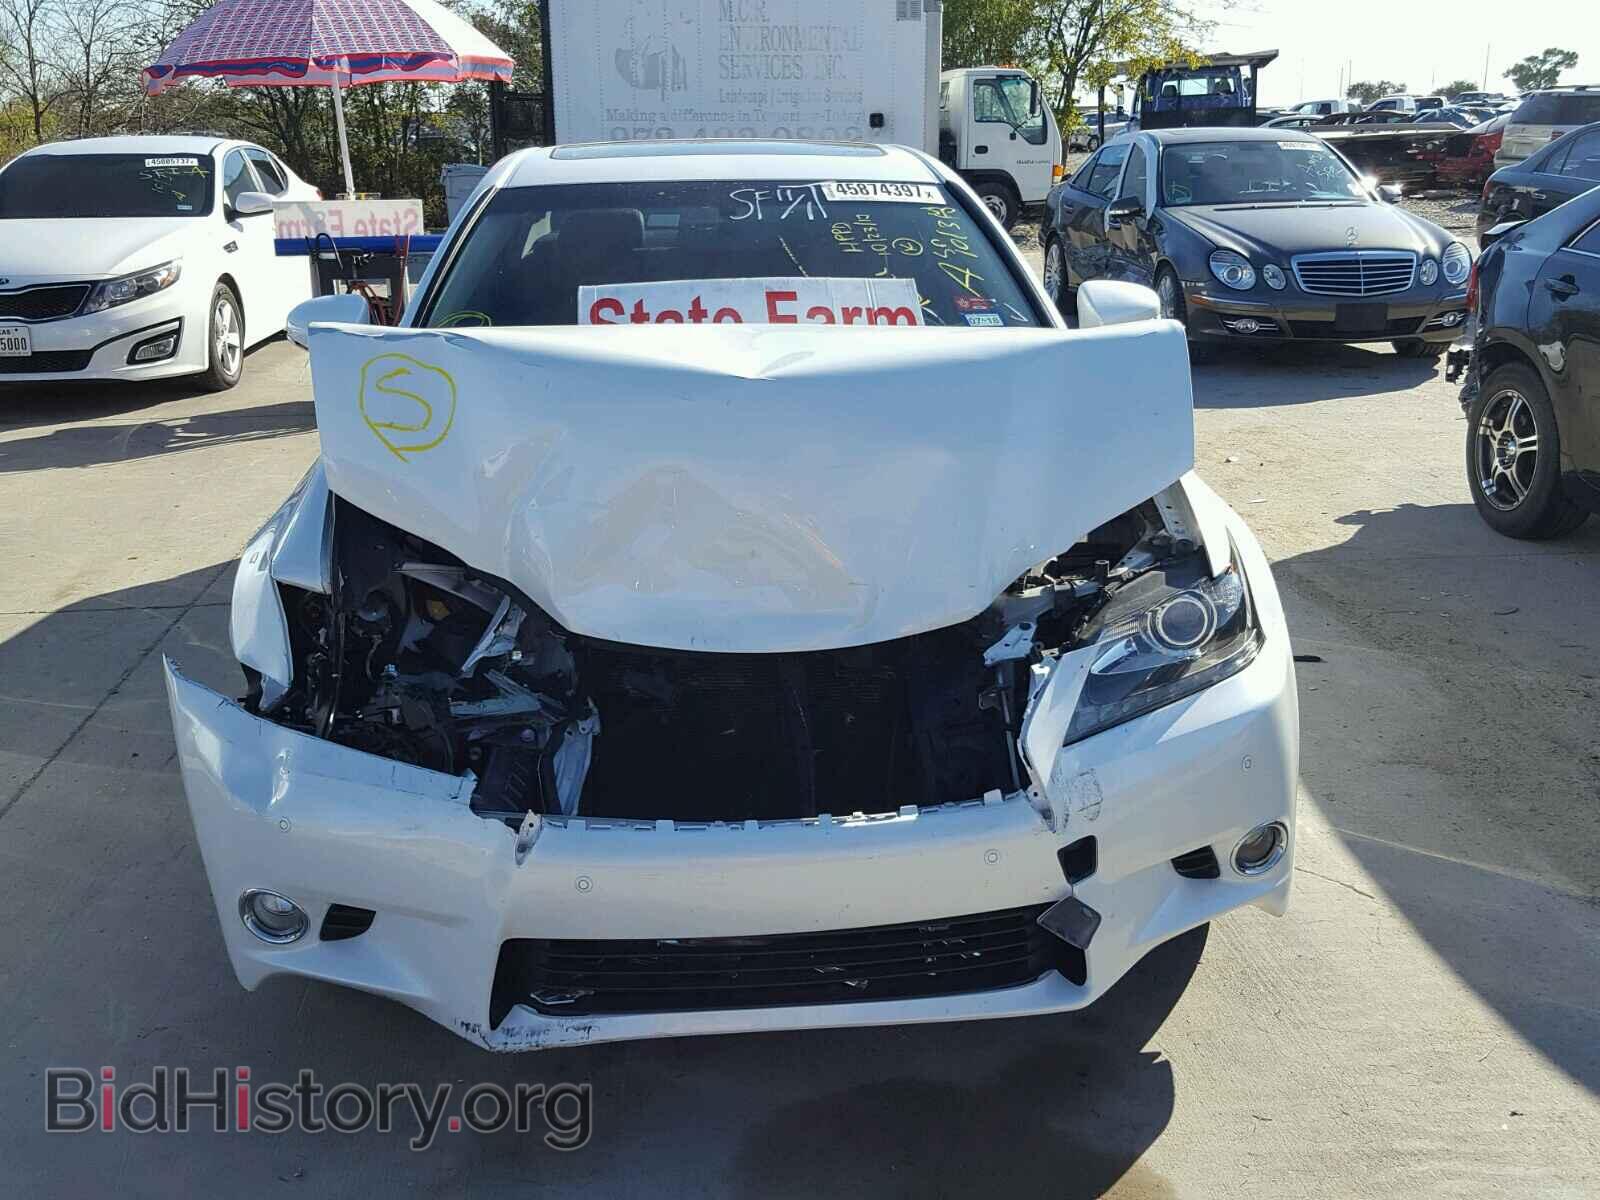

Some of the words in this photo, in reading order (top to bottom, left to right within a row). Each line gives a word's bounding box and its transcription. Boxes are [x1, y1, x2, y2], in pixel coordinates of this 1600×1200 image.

[718, 26, 863, 51] ENRONMENTAL
[606, 109, 656, 123] Making
[836, 183, 921, 198] 45874397
[0, 337, 27, 351] 5000
